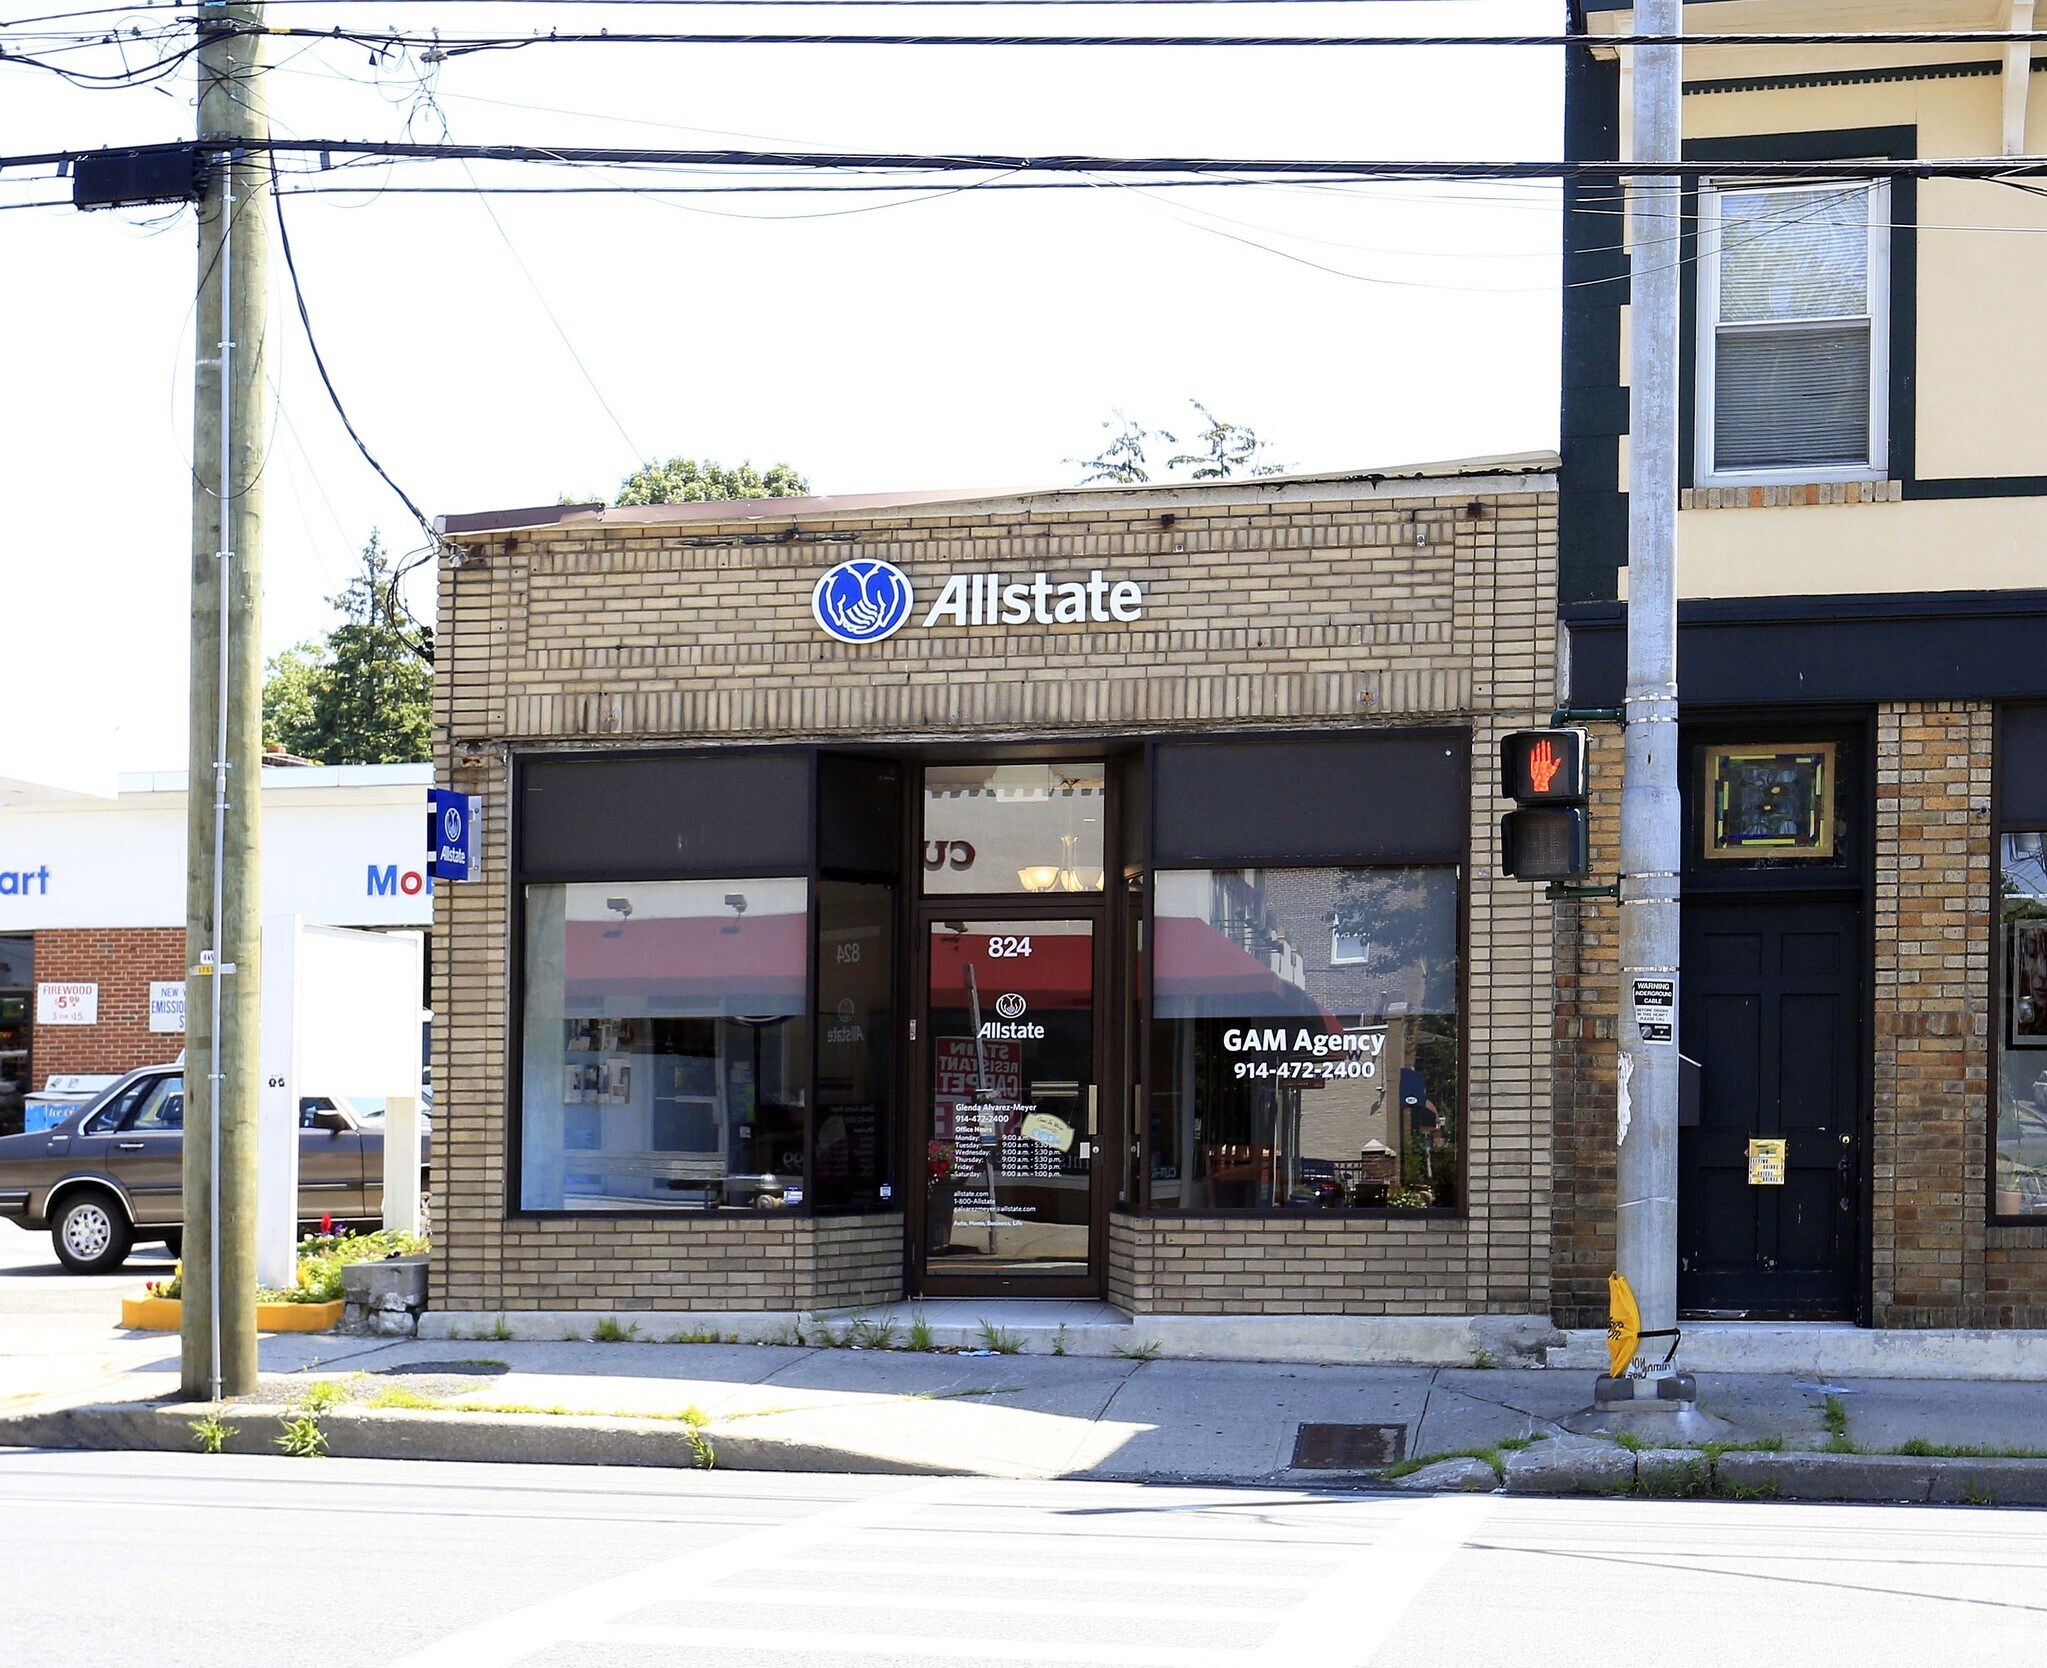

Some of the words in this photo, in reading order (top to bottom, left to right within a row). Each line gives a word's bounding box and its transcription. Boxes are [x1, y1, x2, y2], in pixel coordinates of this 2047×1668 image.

[922, 570, 1142, 627] Allstate
[440, 845, 466, 864] Allstate
[0, 865, 50, 895] art
[367, 864, 433, 895] Mo
[988, 936, 1032, 957] 824
[43, 985, 92, 995] FIREWOOD
[161, 987, 178, 997] NEW
[1637, 982, 1670, 990] WARNING
[151, 1001, 187, 1015] EMISSIO
[976, 1022, 1045, 1039] Allstate
[1223, 1029, 1287, 1052] GAM
[1293, 1029, 1386, 1056] Agency
[1234, 1061, 1376, 1079] 914-472-2400
[955, 1103, 981, 1112] Glenda
[983, 1103, 1037, 1113] Alvarez-Meyer
[955, 1114, 1010, 1123] 914-472-2400
